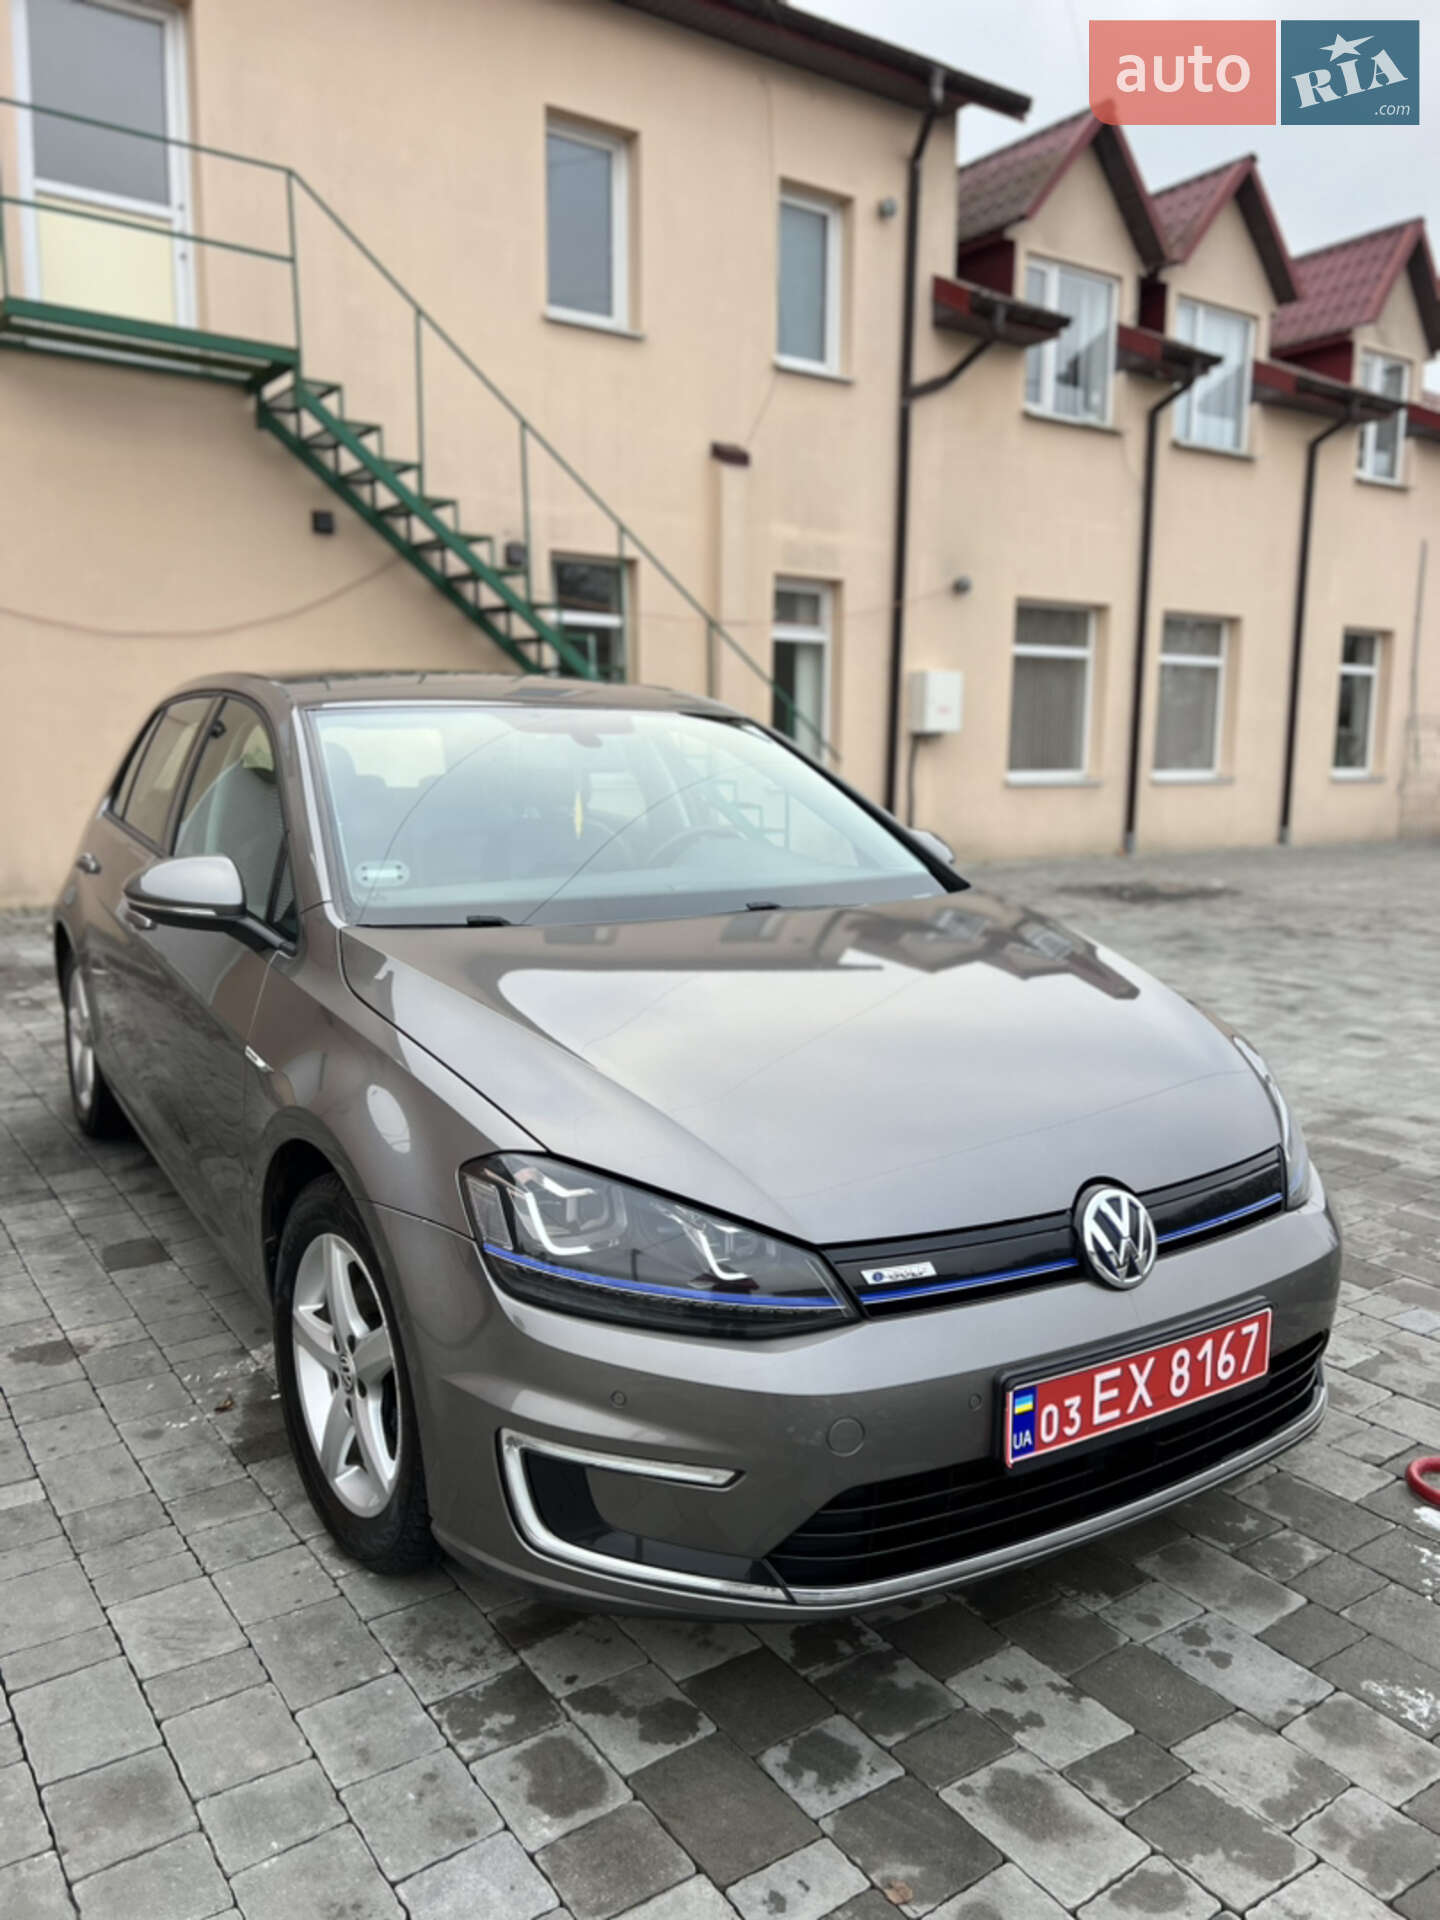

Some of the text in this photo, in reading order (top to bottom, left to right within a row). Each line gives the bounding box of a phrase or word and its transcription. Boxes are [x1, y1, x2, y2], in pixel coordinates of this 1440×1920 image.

[1040, 1321, 1260, 1444] 03 EX 8167
[1012, 1429, 1033, 1450] UA
